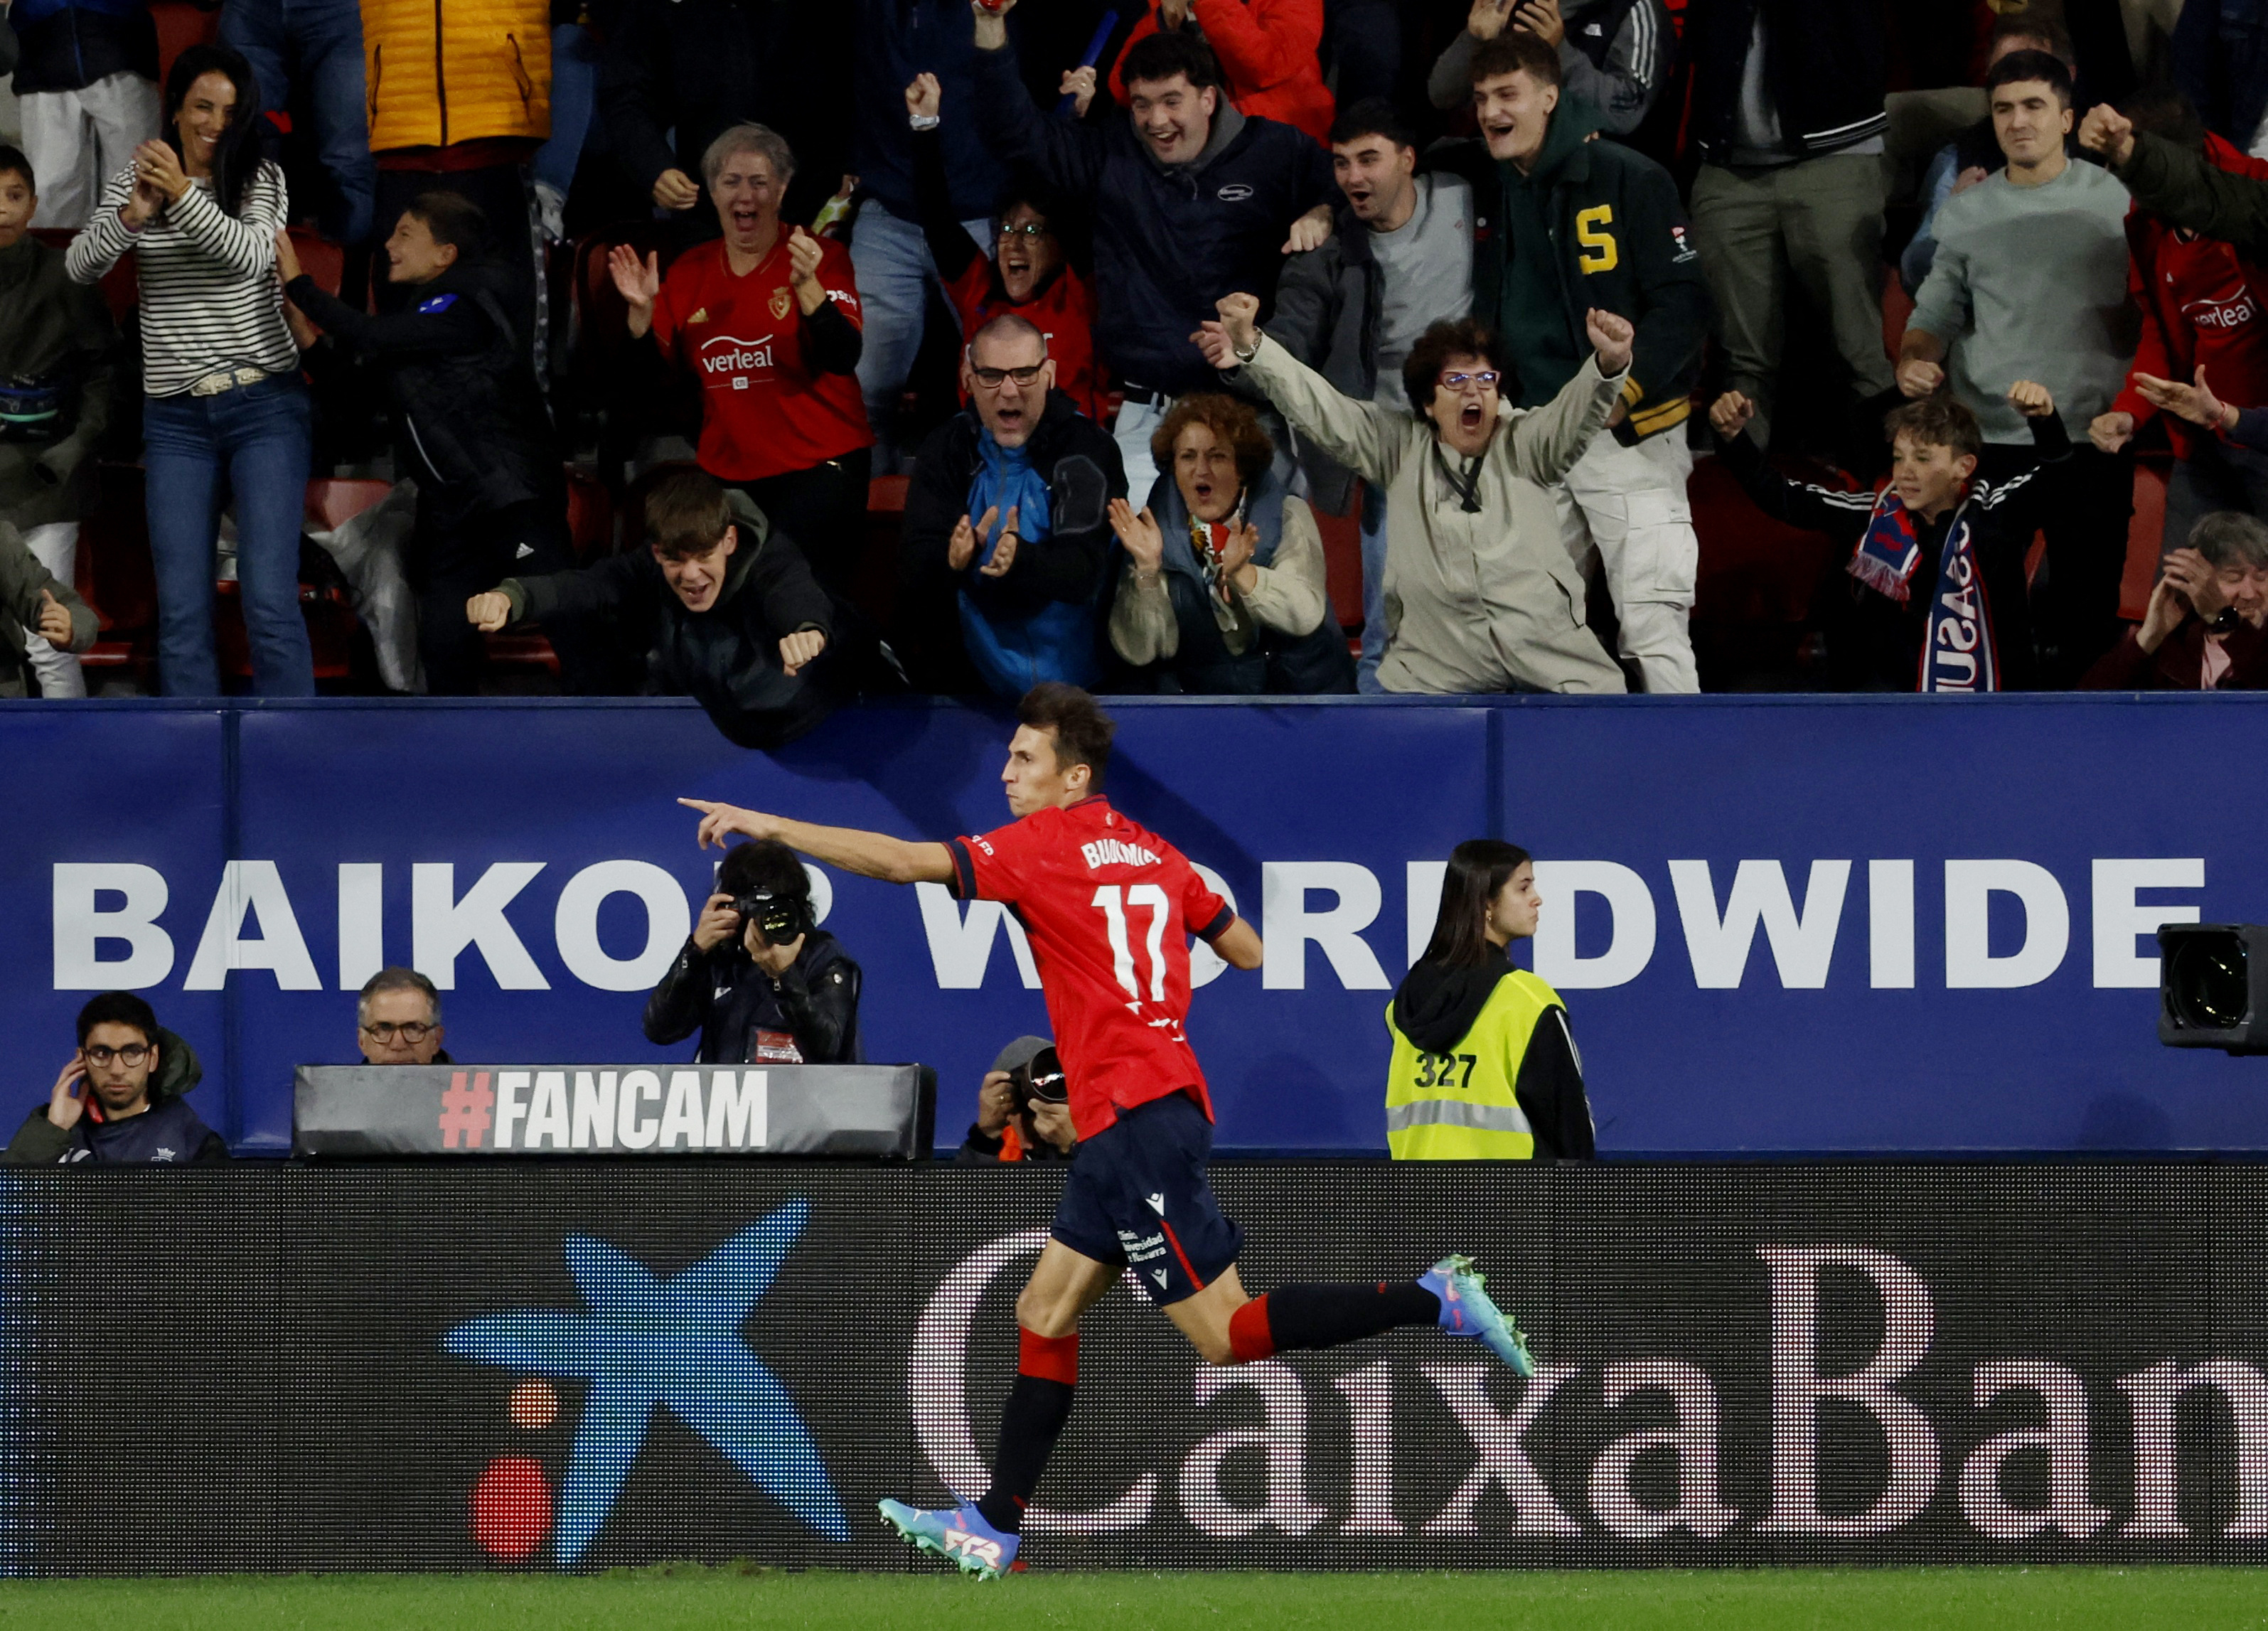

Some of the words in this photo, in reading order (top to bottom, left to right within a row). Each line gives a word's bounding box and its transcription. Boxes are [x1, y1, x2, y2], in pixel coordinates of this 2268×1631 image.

[1576, 204, 1618, 275] S
[702, 346, 774, 373] verleal
[1091, 884, 1169, 1002] 17
[1414, 1052, 1477, 1088] 327
[439, 1070, 768, 1150] #FANCAM
